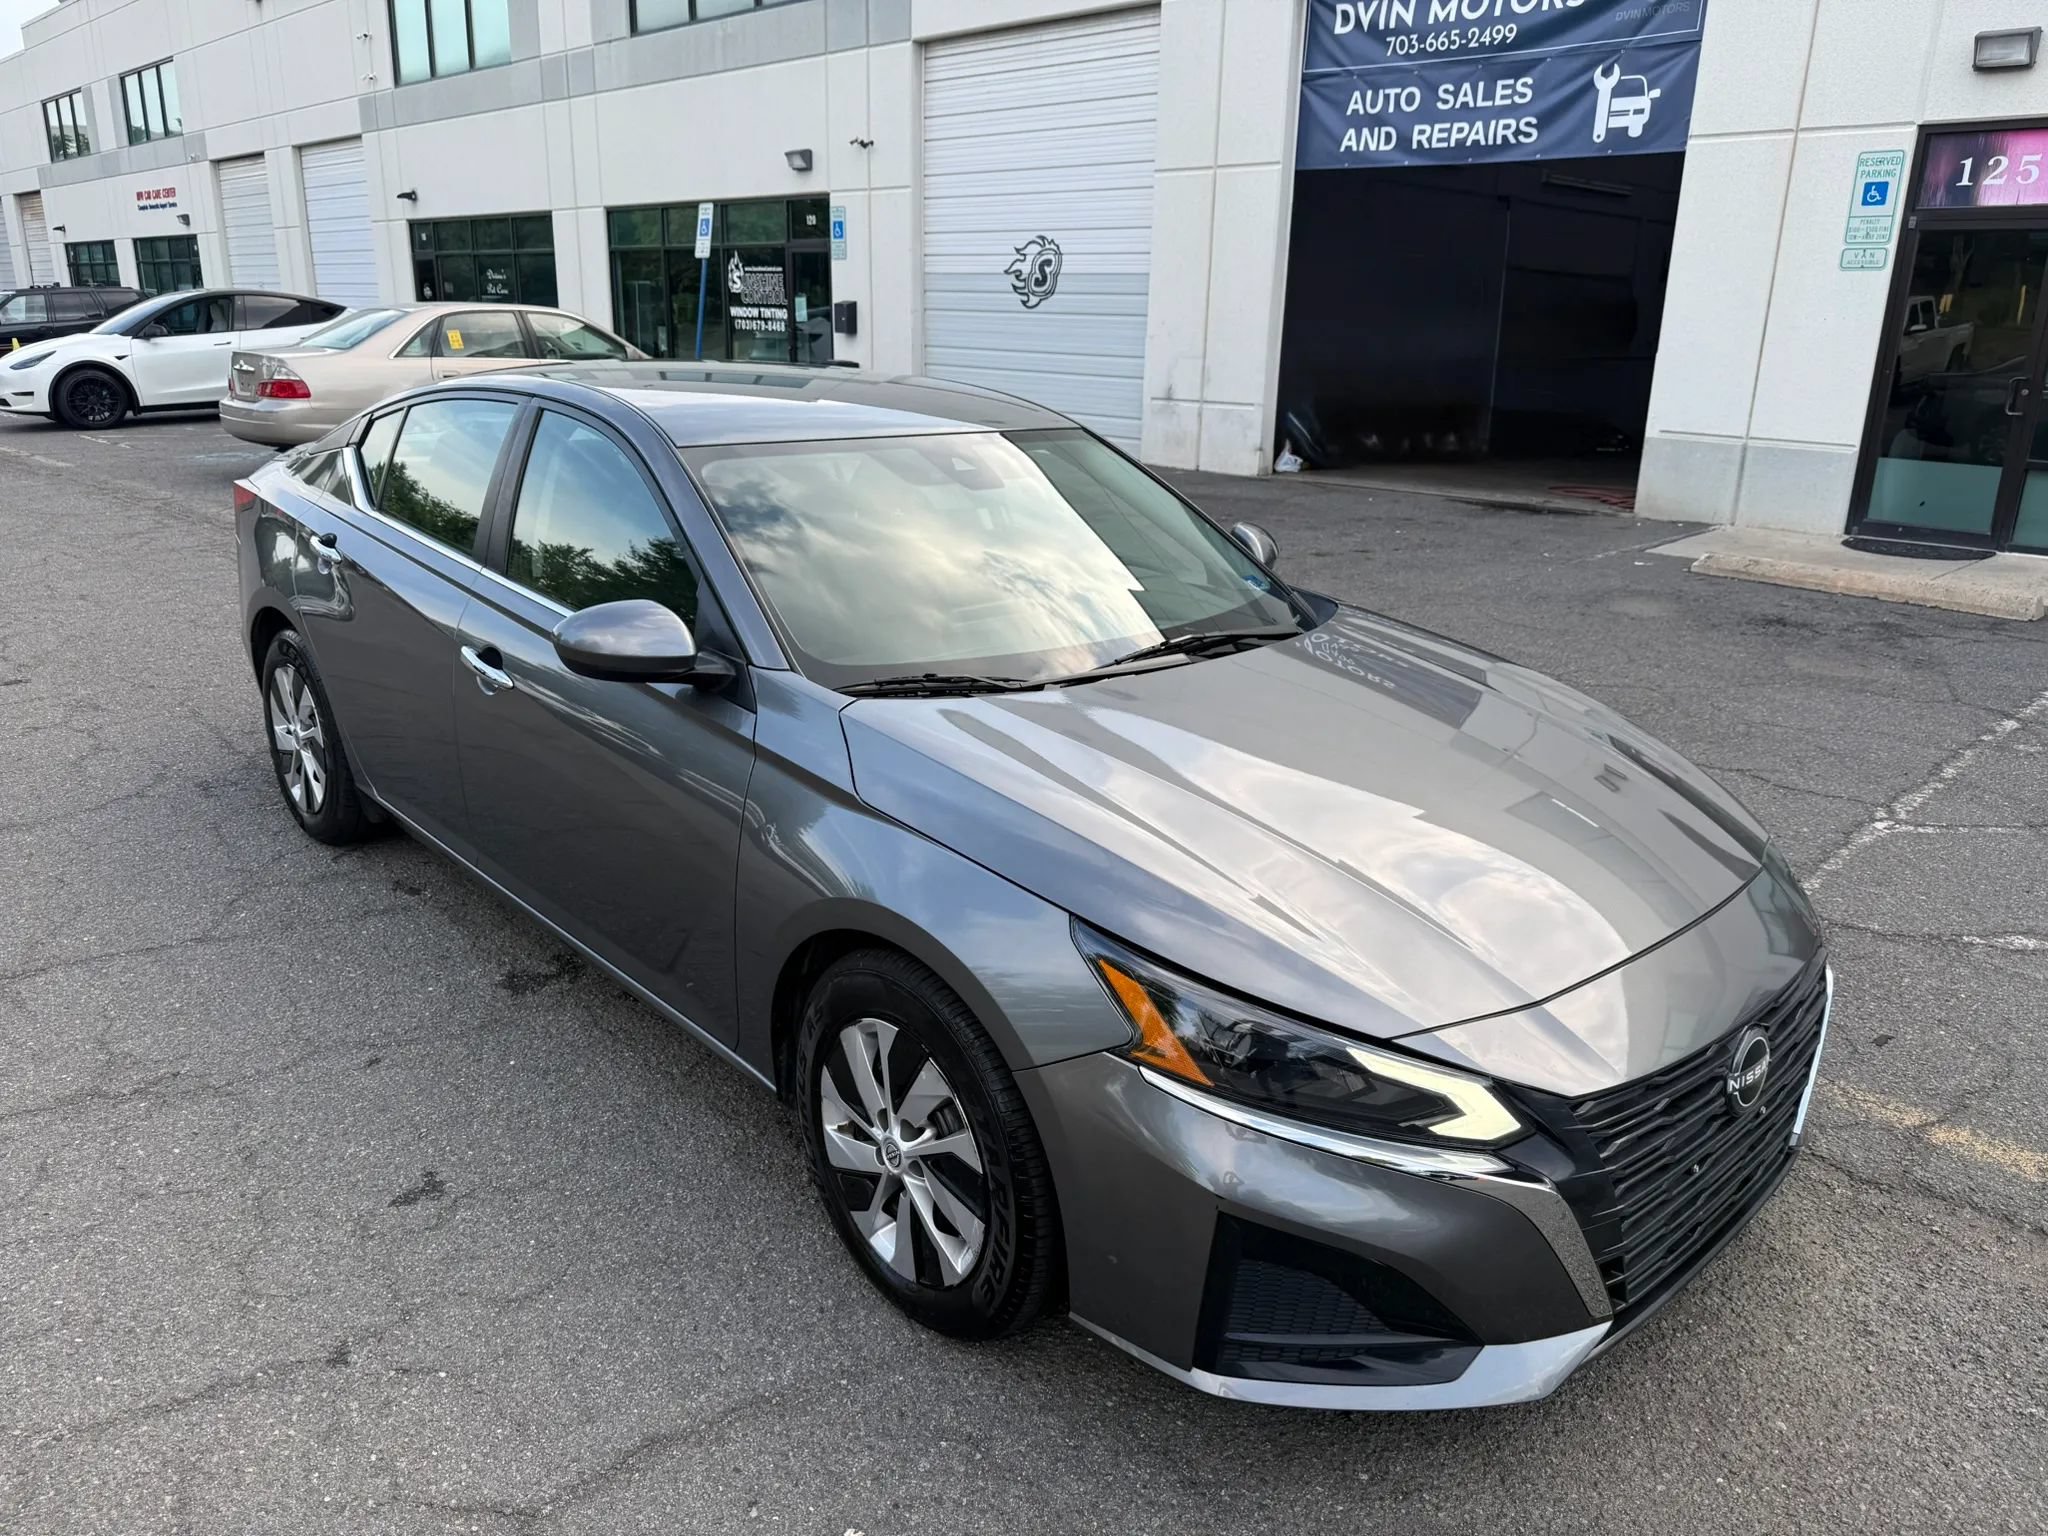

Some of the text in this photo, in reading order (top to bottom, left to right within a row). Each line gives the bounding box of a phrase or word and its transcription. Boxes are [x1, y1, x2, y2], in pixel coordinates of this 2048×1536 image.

[1333, 0, 1586, 35] DVIN MOT
[1385, 23, 1518, 57] 703-665-2499
[1346, 76, 1534, 117] AUTO SALES
[1339, 116, 1539, 153] AND REPAIRS
[1859, 156, 1902, 168] RESERVED
[1860, 168, 1896, 179] PARKING
[1955, 152, 2043, 187] 125
[730, 306, 788, 320] WINDOW TINTING
[741, 289, 788, 305] CONTROL
